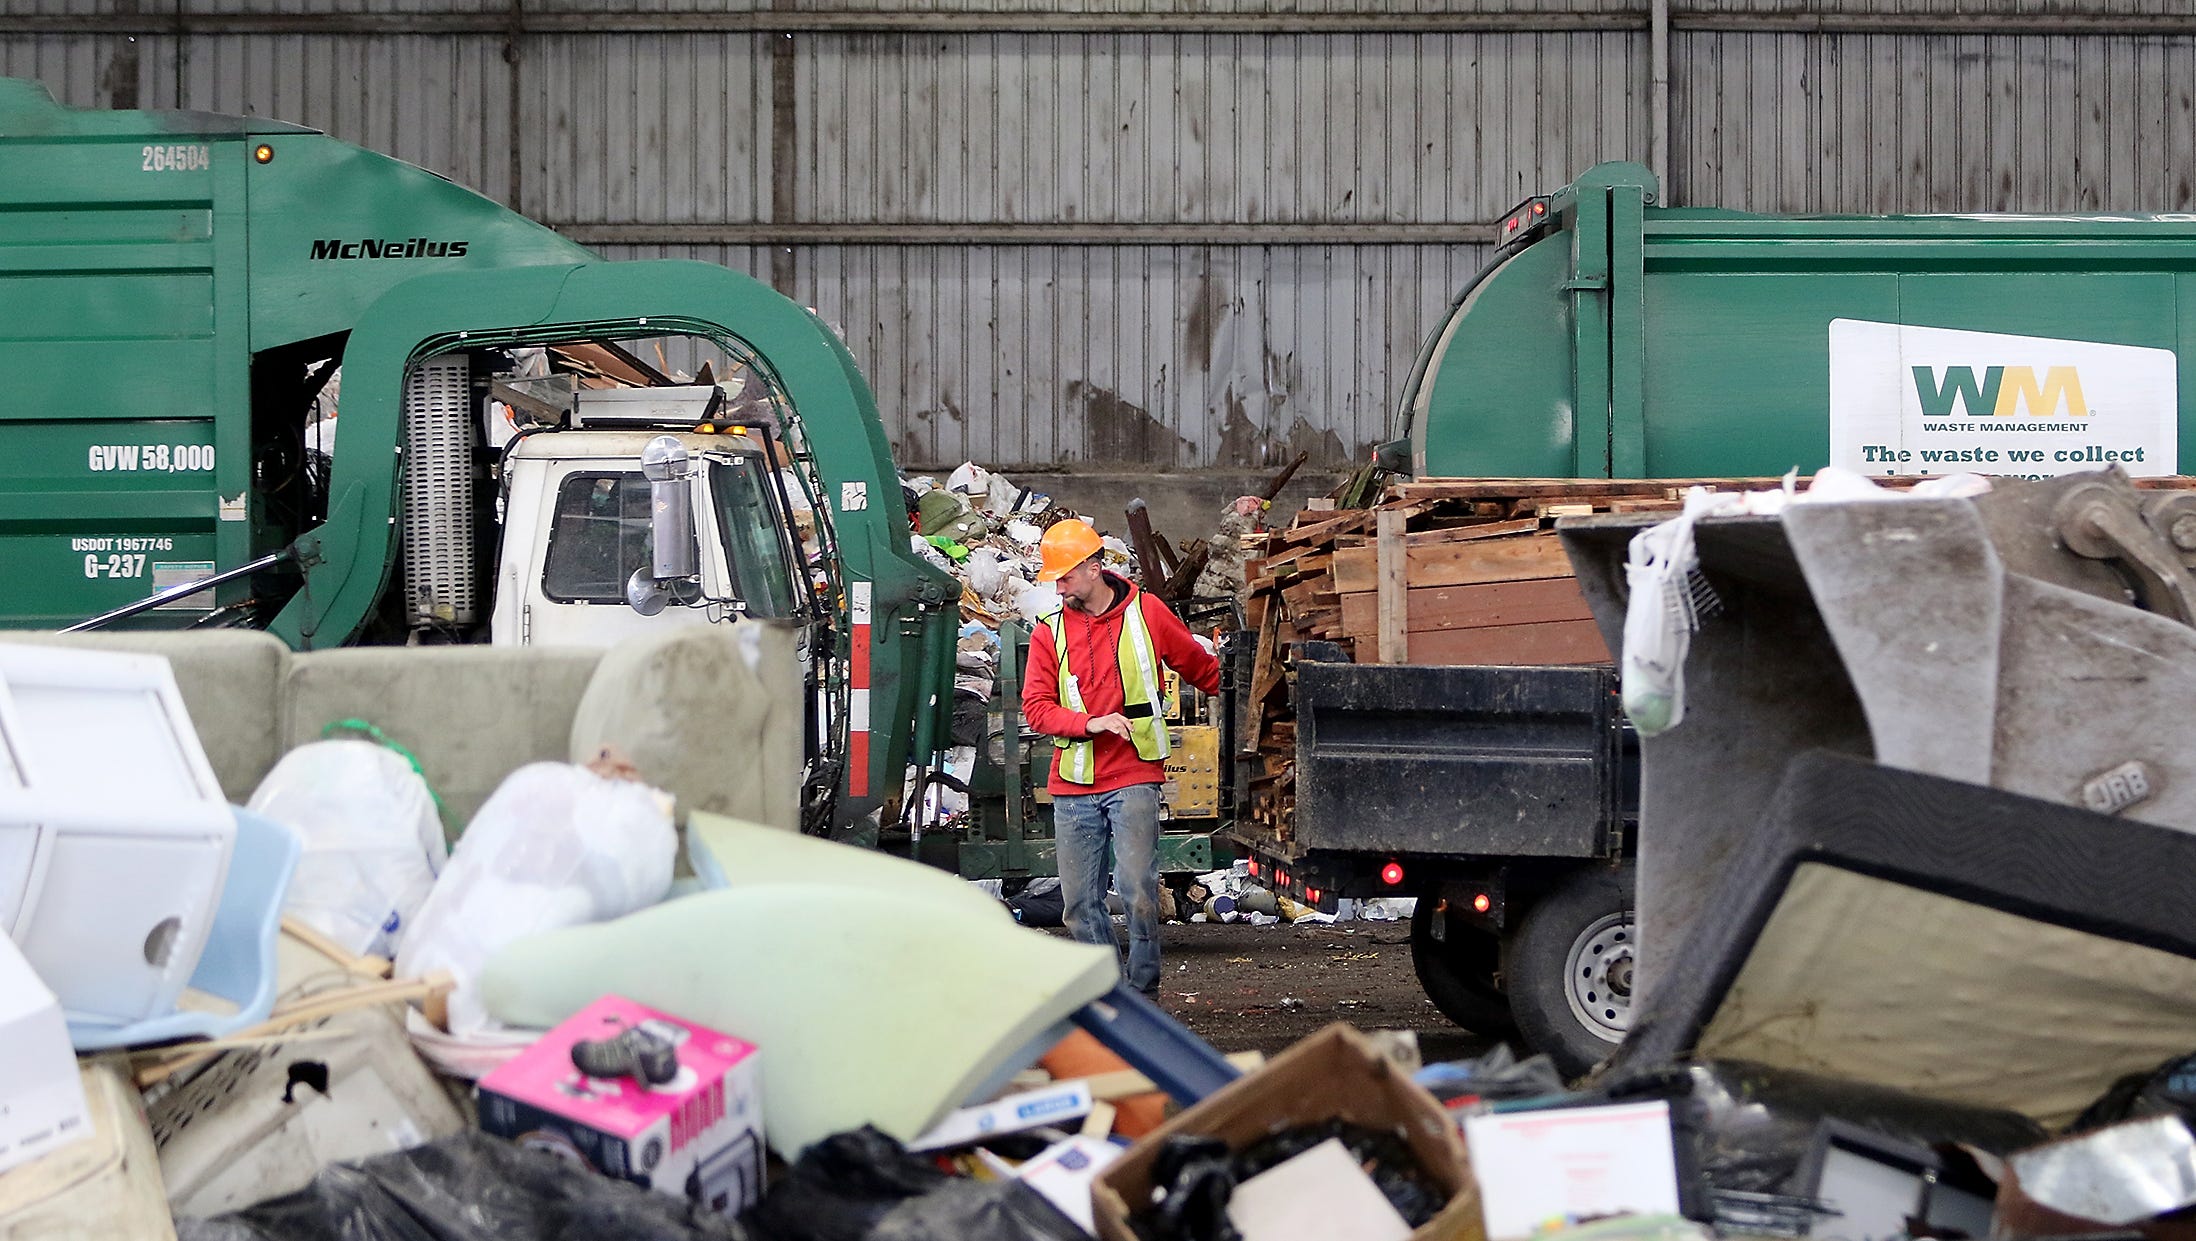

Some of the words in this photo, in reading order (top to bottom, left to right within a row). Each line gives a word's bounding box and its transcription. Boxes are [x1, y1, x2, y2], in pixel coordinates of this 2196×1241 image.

[142, 145, 209, 171] 264504
[310, 238, 469, 260] McNeilus
[1911, 365, 2088, 416] WM
[1923, 423, 1975, 432] WASTE
[1980, 423, 2089, 432] MANAGEMENT
[88, 445, 139, 471] GVW
[142, 444, 215, 473] 58,000
[1862, 445, 1912, 463] The
[1920, 445, 2000, 463] waste
[2007, 449, 2046, 463] we
[2053, 445, 2145, 463] collect
[72, 538, 114, 551] USDOT
[115, 538, 173, 551] 1967746
[84, 553, 146, 578] G-237
[2092, 767, 2149, 809] JRB
